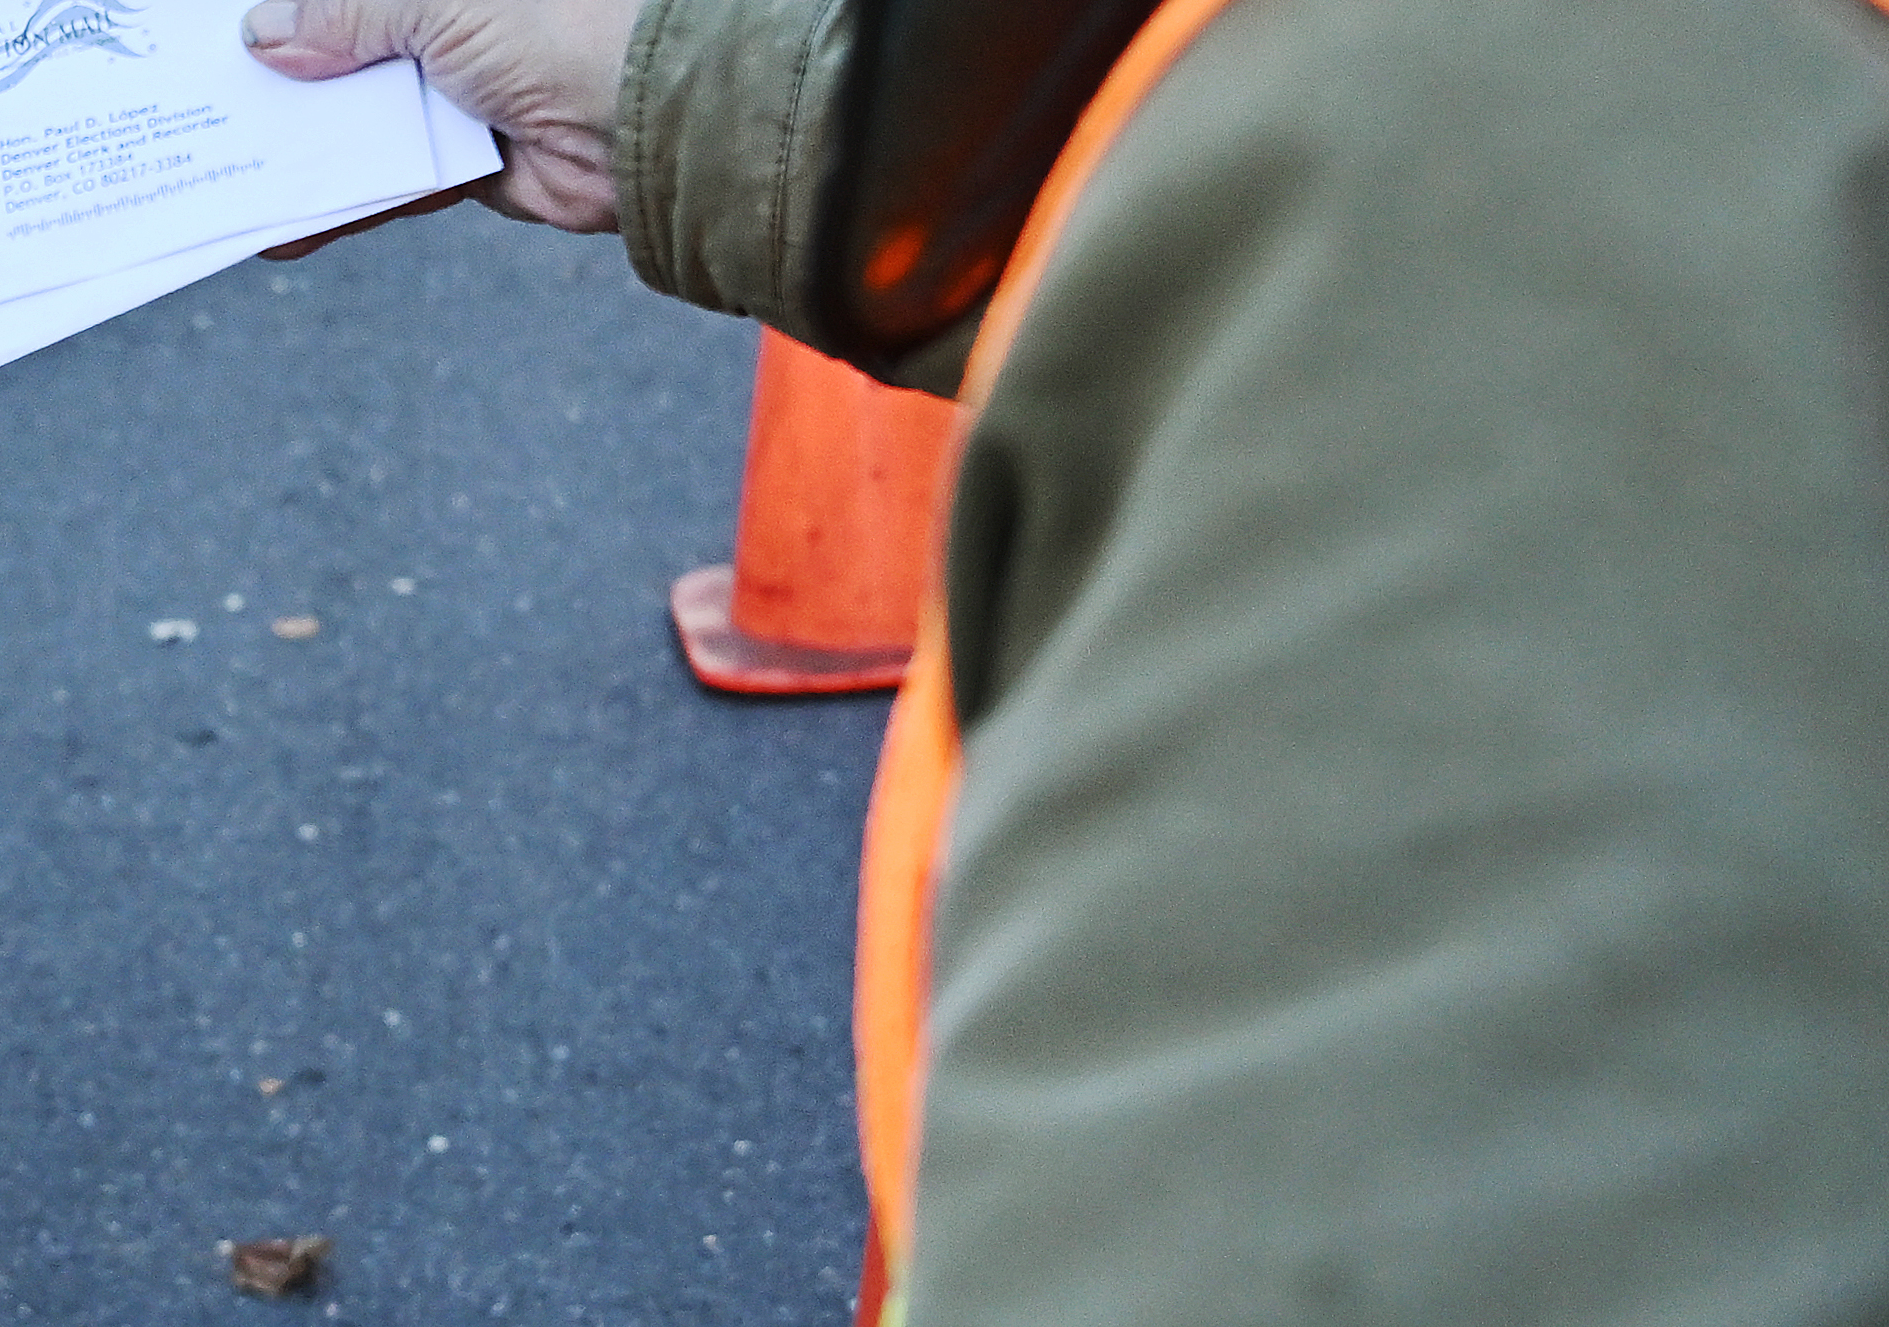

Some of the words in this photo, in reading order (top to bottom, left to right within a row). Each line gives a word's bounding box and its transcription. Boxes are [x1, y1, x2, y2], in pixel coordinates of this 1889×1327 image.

[59, 10, 119, 44] MAIL
[0, 136, 38, 150] Hon.
[44, 121, 80, 138] Paul
[85, 117, 103, 129] D.
[109, 104, 158, 124] López
[0, 143, 60, 166] Denver
[66, 123, 141, 150] Elections
[147, 105, 213, 129] Division
[2, 158, 60, 182] Denver
[66, 145, 110, 164] Clerk
[116, 135, 147, 151] and
[152, 115, 229, 141] Recorder
[3, 179, 39, 197] P.O.
[44, 170, 71, 187] Box
[72, 177, 96, 195] CO
